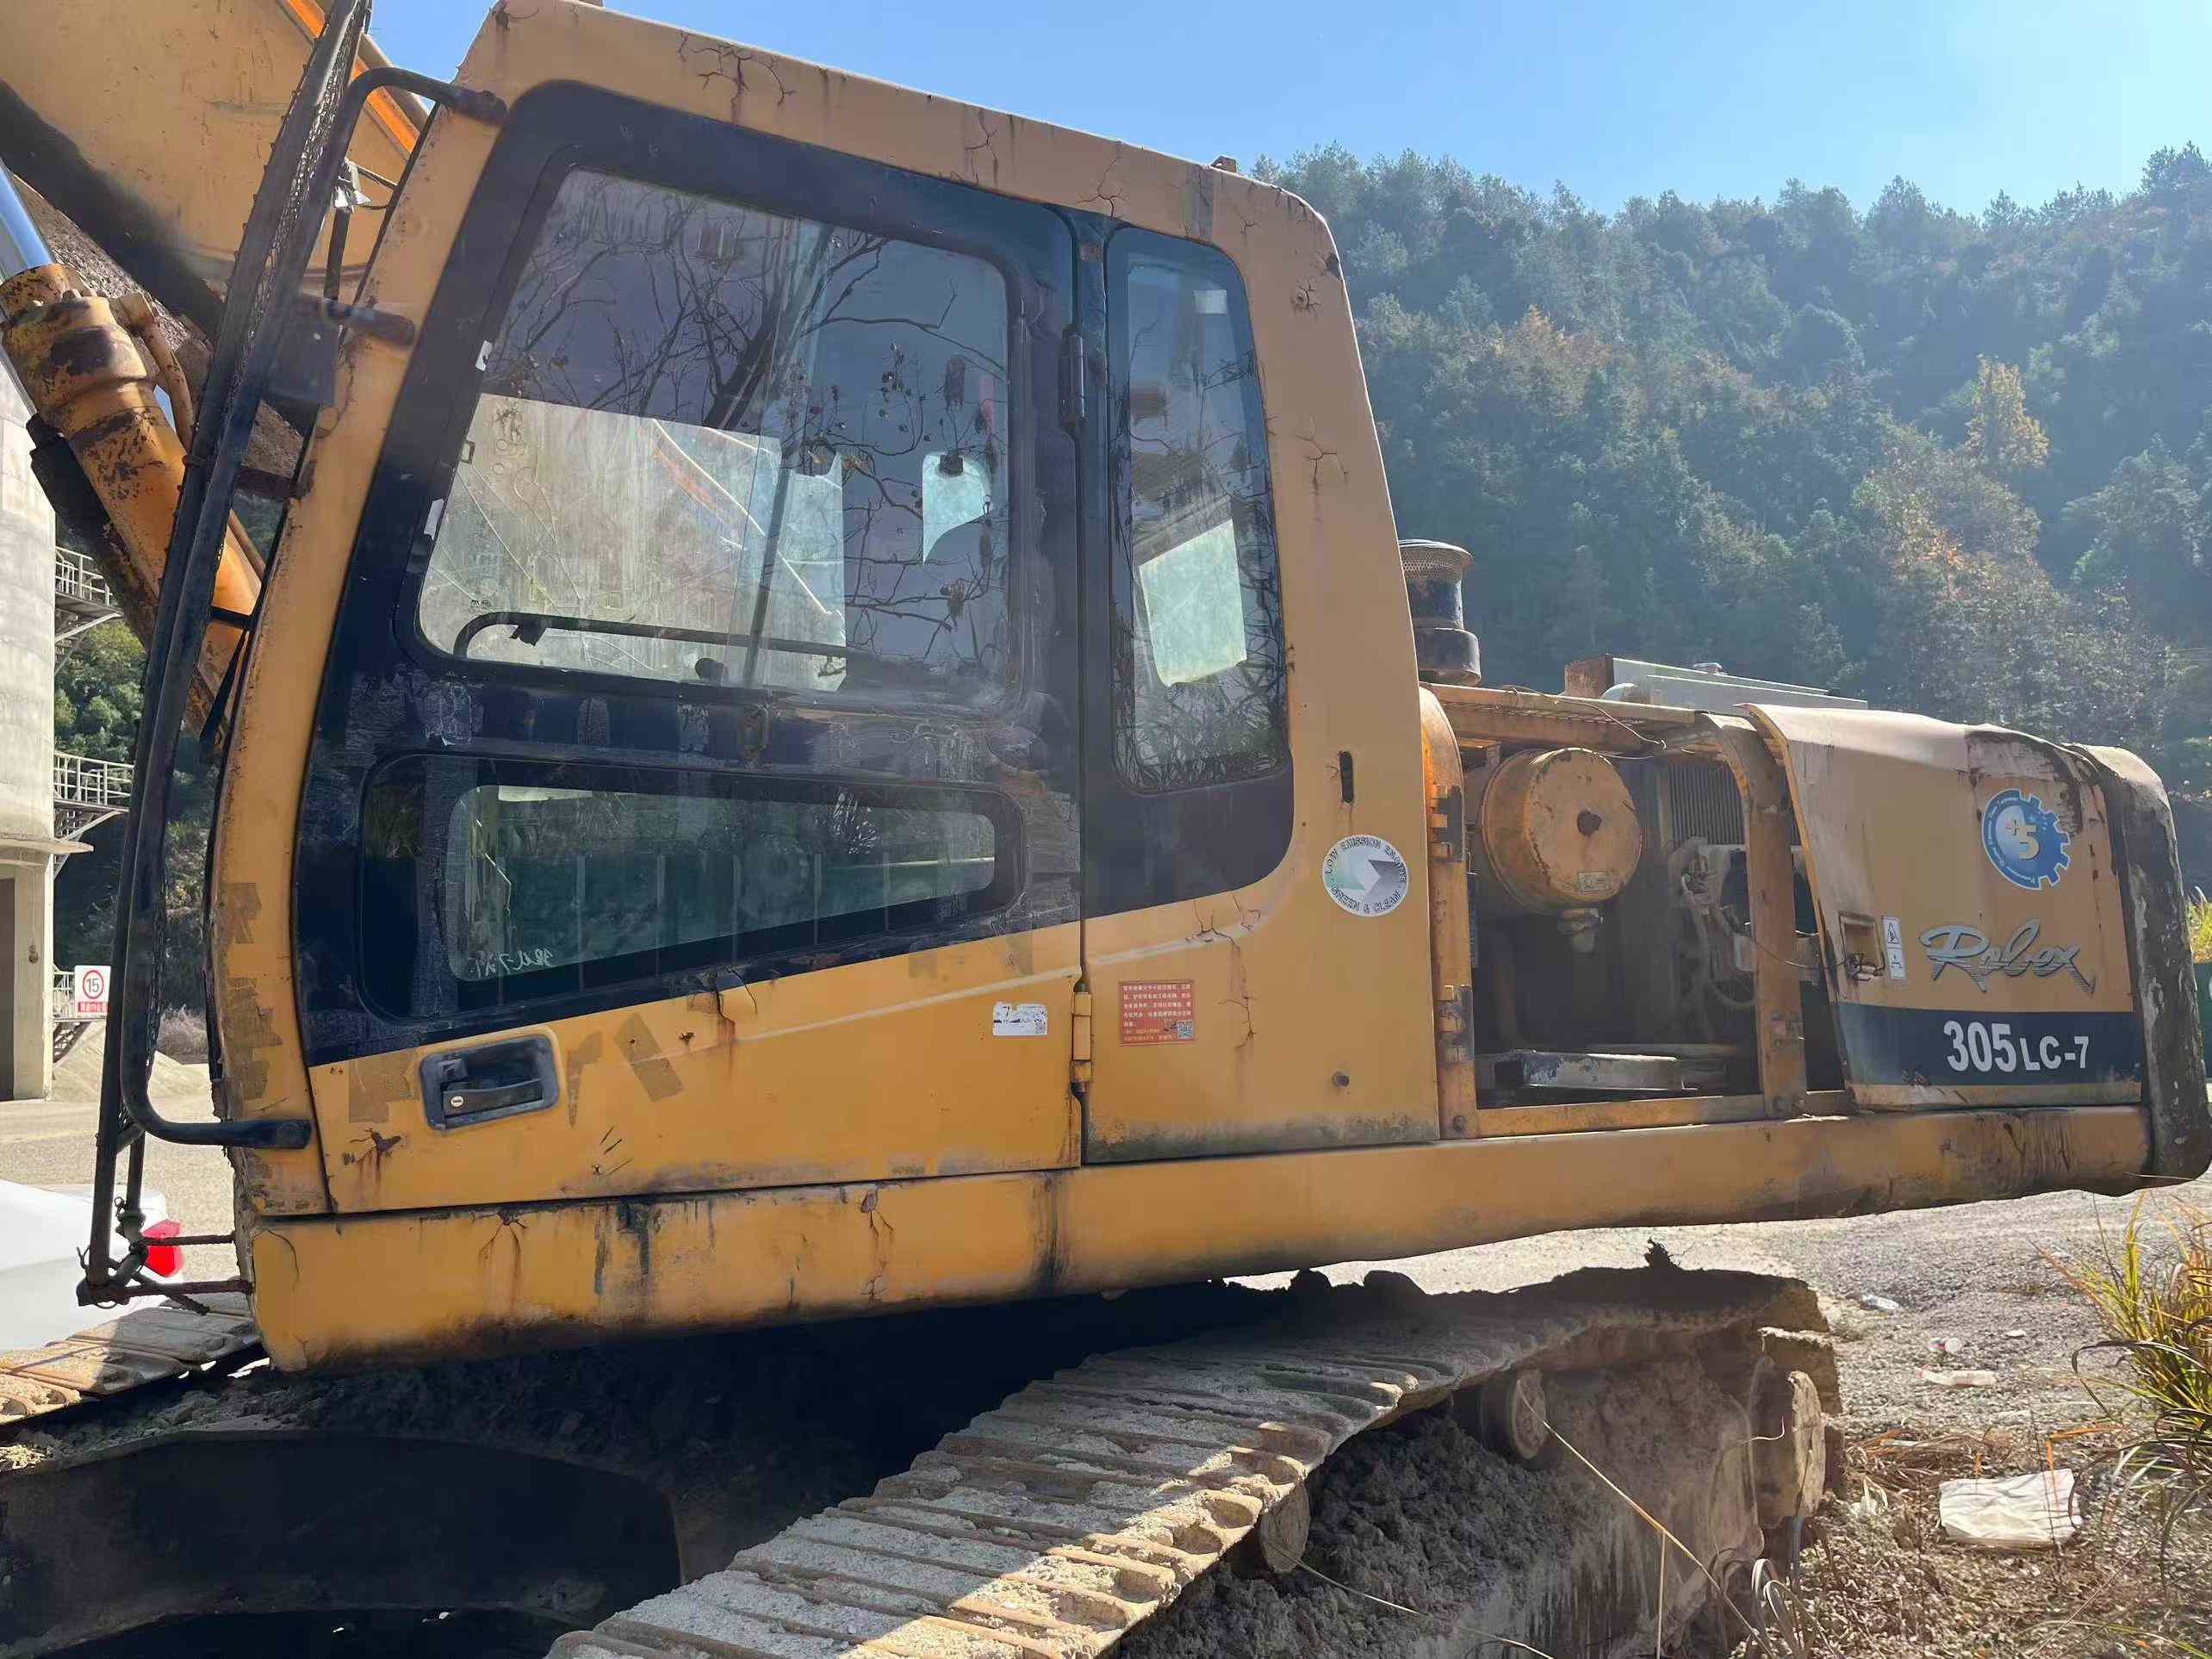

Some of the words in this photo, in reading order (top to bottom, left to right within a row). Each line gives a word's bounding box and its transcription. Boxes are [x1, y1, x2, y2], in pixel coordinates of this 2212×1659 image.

[1326, 848, 1338, 875] LOW
[1341, 836, 1382, 850] EMISSION
[1384, 845, 1407, 884] ENGINE
[1331, 880, 1360, 911] GREEN
[1374, 889, 1401, 911] CLEAN
[86, 978, 100, 993] 15
